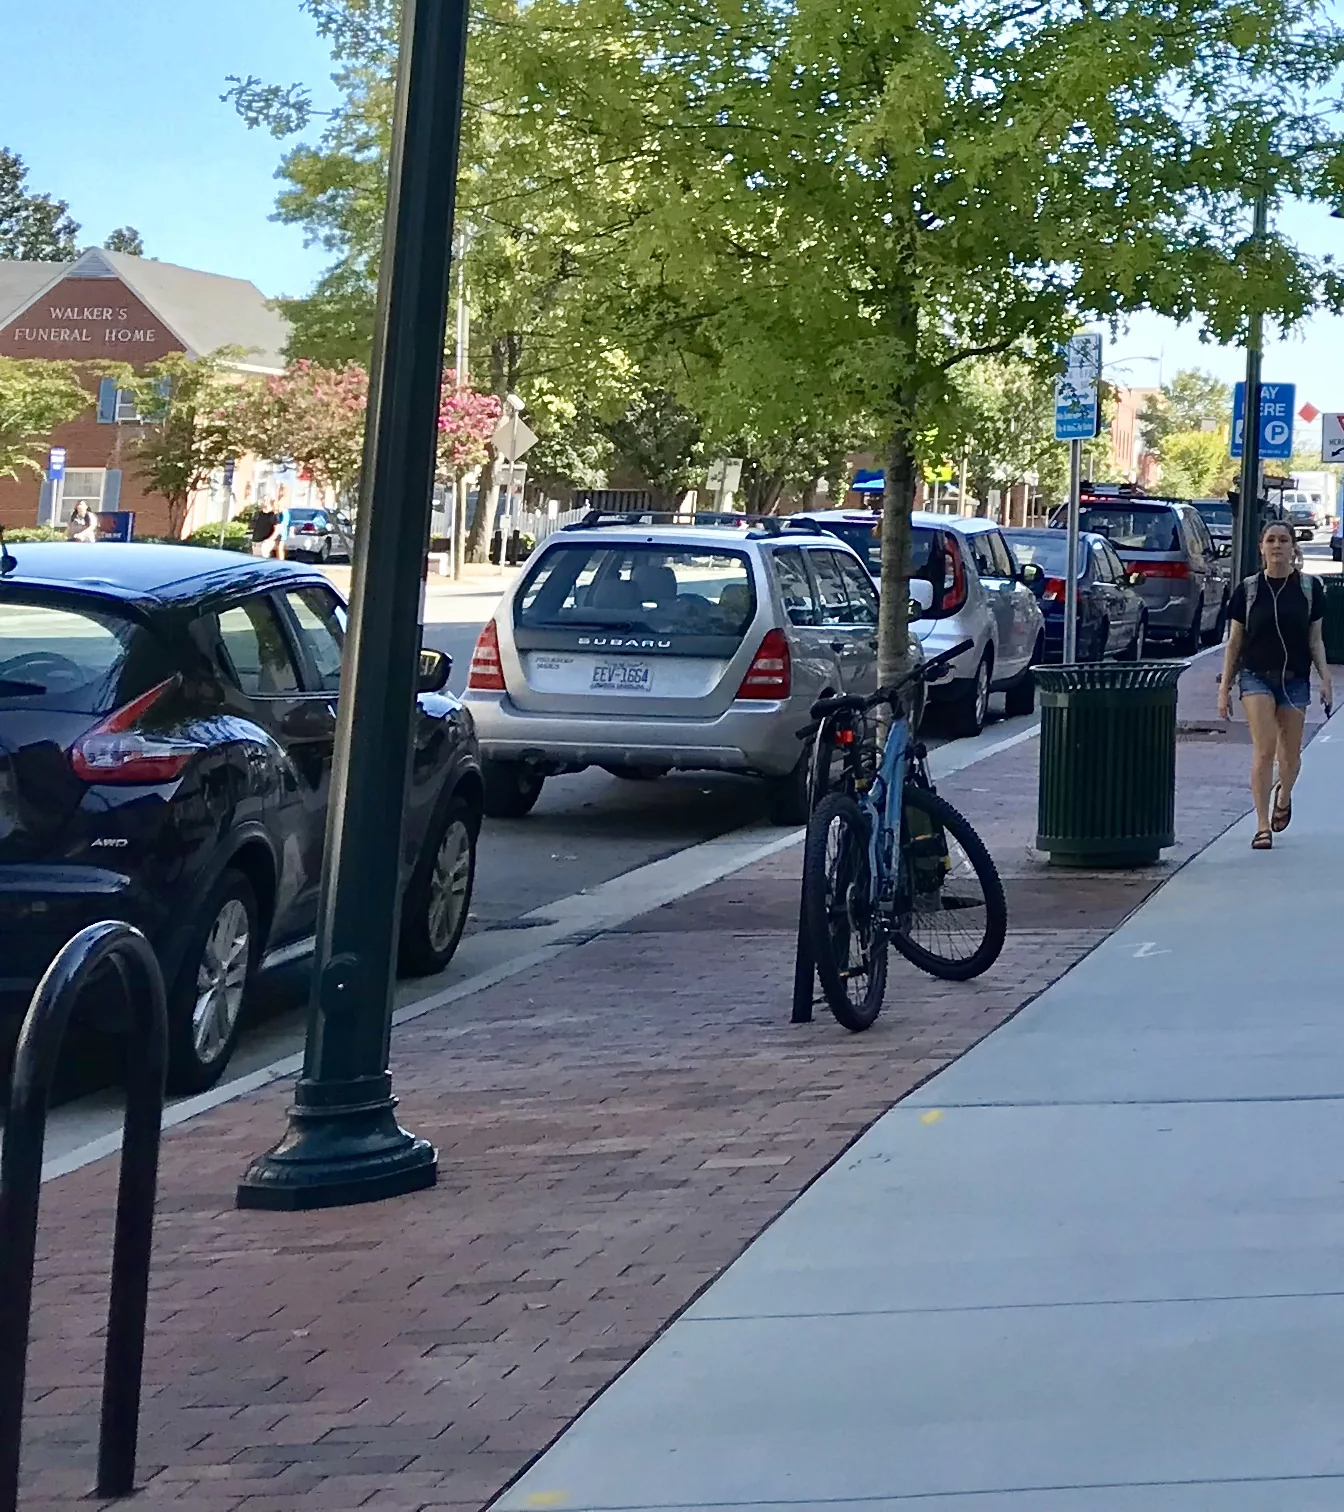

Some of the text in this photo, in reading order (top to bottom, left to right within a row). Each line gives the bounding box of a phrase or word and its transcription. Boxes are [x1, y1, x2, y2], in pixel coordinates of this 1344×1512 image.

[50, 307, 128, 320] WALKER'S
[14, 328, 156, 342] FUNERAL HOME
[1260, 386, 1279, 400] AY
[578, 638, 671, 648] SUBARU
[592, 666, 650, 685] EEV-1664
[90, 838, 129, 848] AWD
